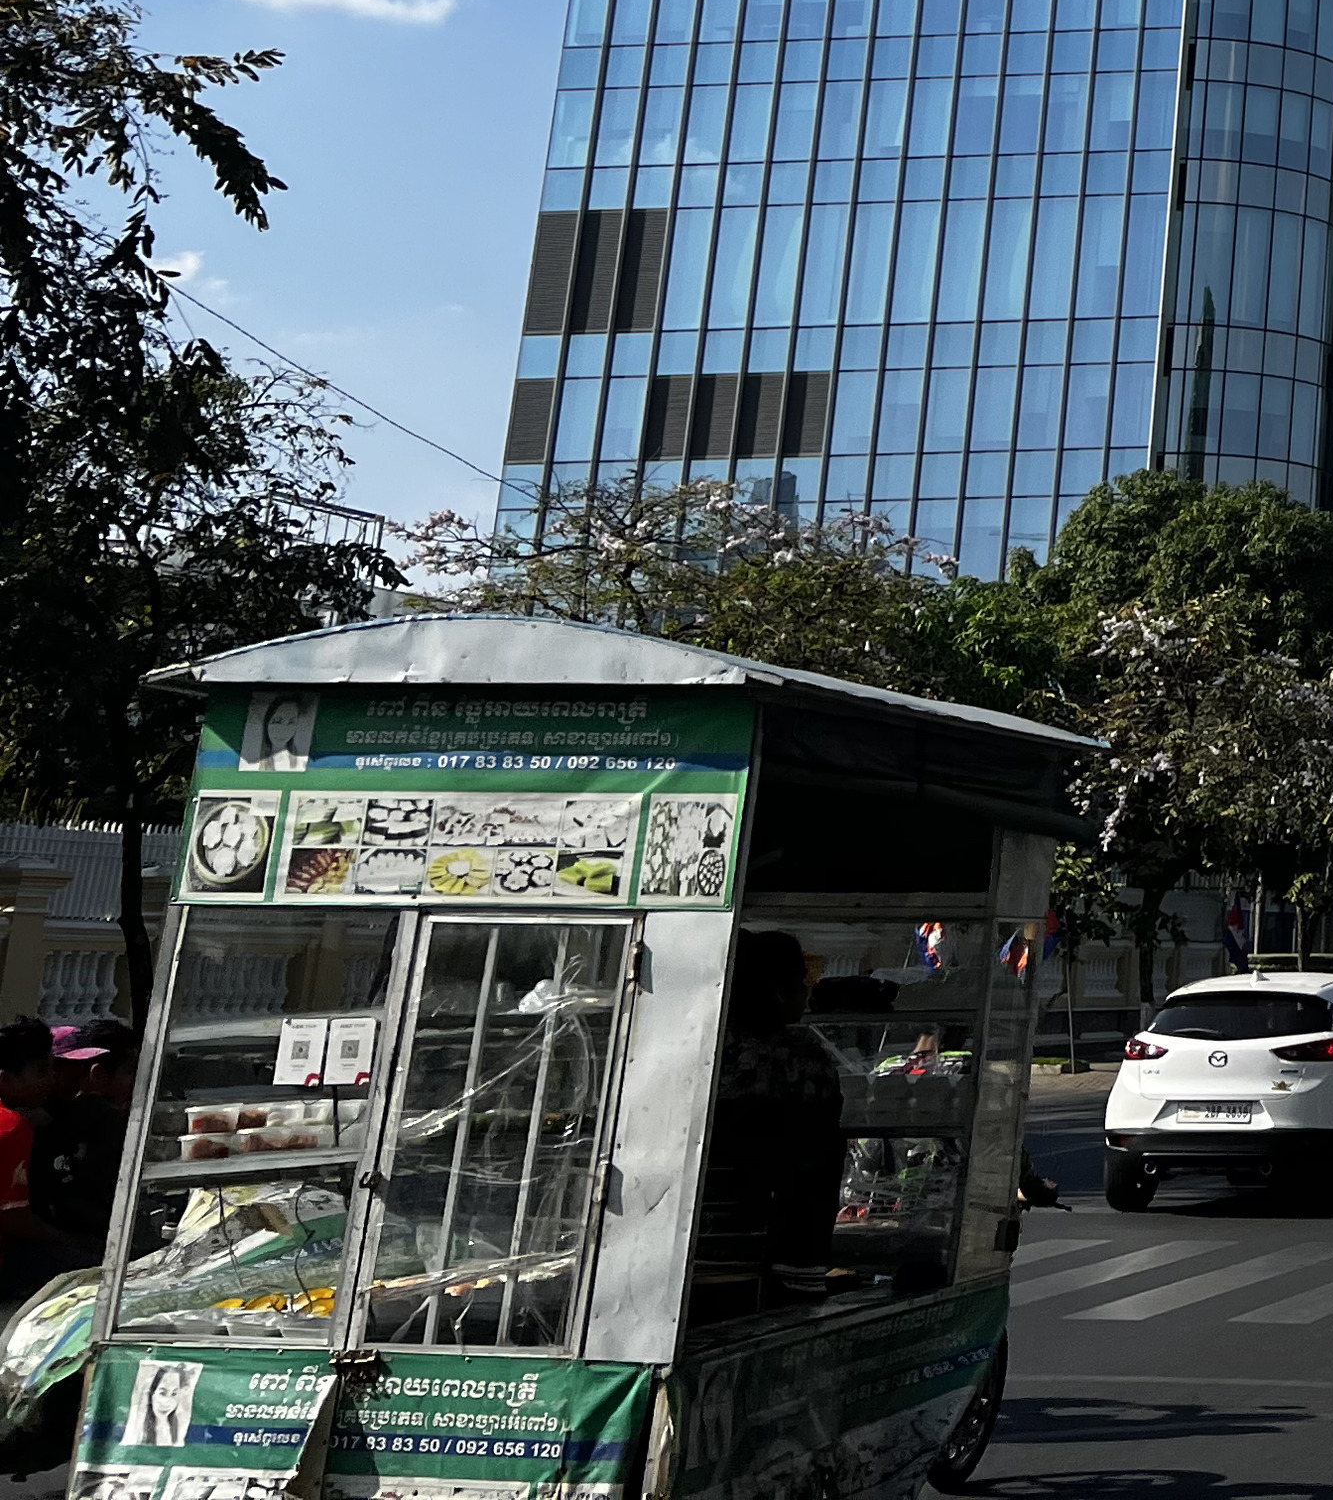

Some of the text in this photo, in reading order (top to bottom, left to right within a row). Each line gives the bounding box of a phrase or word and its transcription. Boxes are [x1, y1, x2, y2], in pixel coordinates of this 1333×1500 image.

[437, 755, 467, 769] 017
[474, 755, 497, 769] 83
[502, 755, 524, 769] 83
[529, 755, 551, 769] 50
[555, 755, 563, 769] /
[567, 755, 599, 769] 092
[605, 755, 638, 770] 656
[645, 756, 677, 770] 120
[365, 1436, 387, 1451] 83
[391, 1437, 414, 1452] 83
[419, 1438, 441, 1453] 50
[444, 1439, 453, 1453] /
[455, 1440, 489, 1455] 092
[493, 1442, 525, 1457] 656
[531, 1443, 561, 1459] 120
